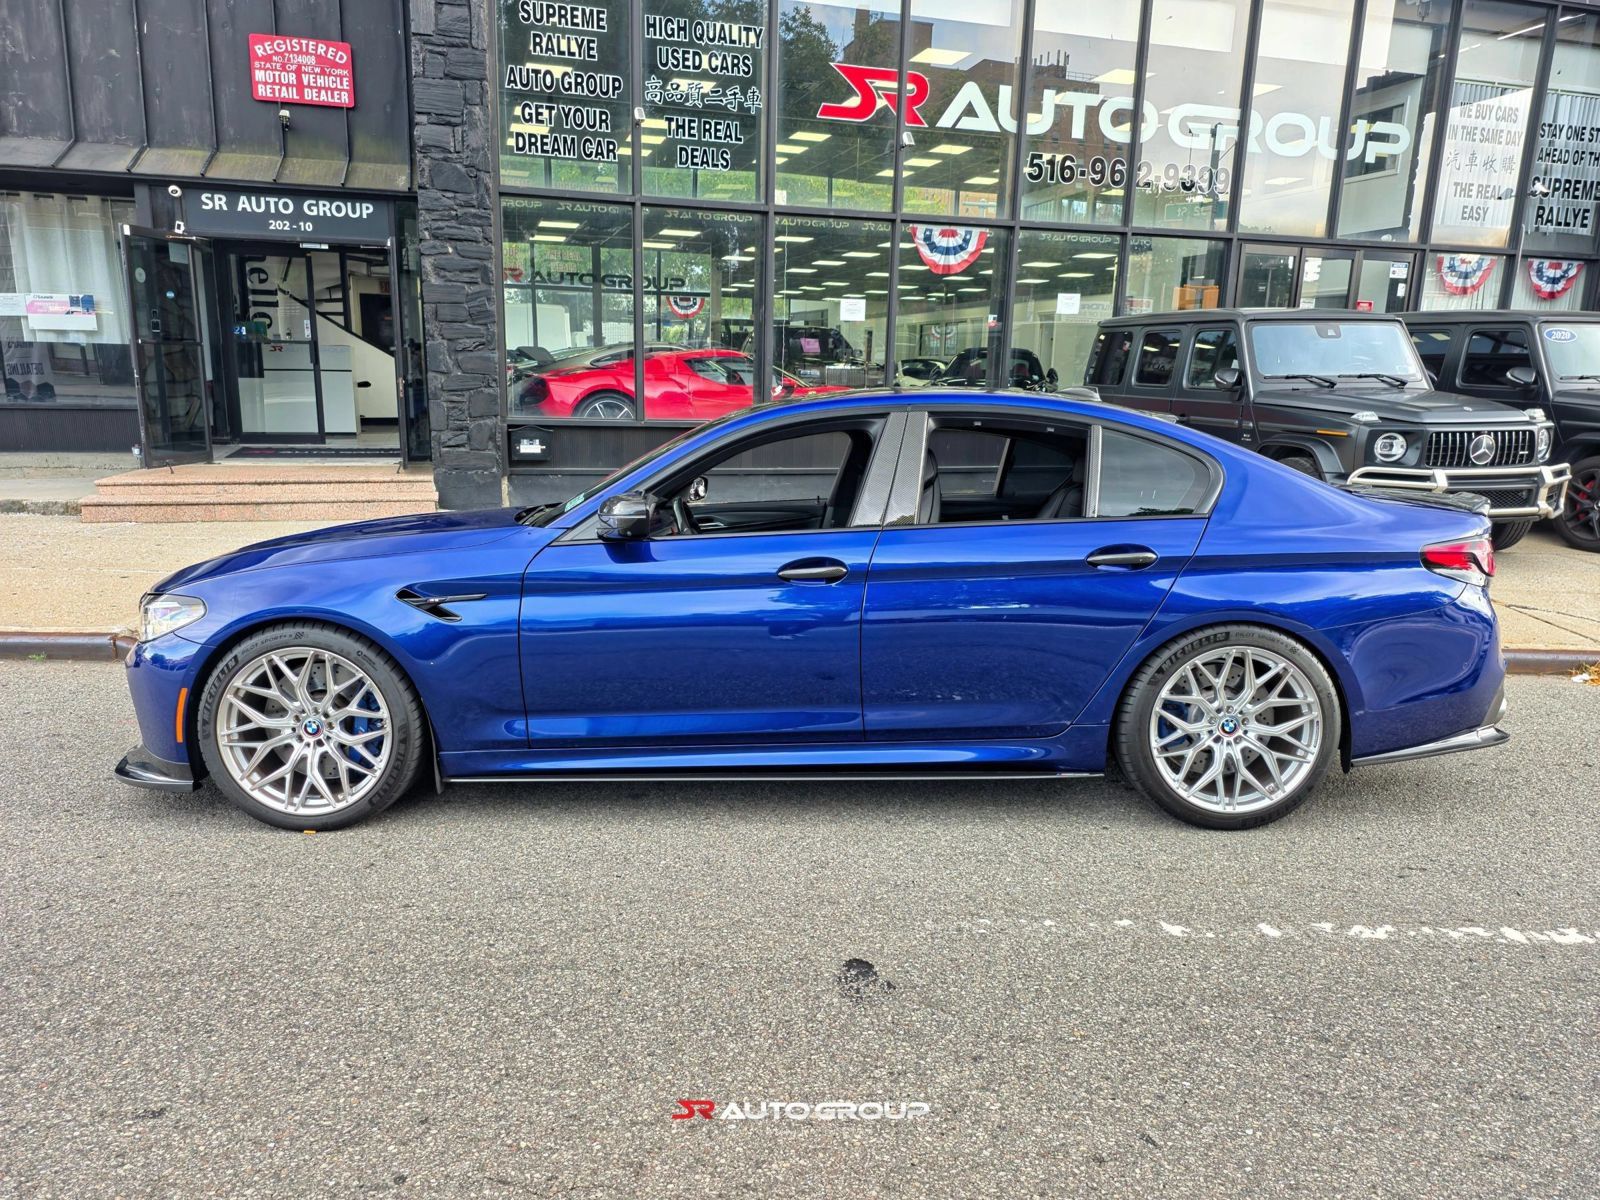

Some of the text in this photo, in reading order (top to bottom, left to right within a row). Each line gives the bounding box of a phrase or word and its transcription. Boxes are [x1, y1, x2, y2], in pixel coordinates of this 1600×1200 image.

[519, 0, 607, 32] SUPREME
[645, 14, 765, 49] HIGH QUALITY
[254, 38, 347, 64] REGISTERED
[531, 31, 598, 61] RALLYE
[254, 61, 349, 77] STATE OF NEW YORK
[657, 46, 752, 78] USED CARS
[255, 70, 350, 89] MOTOR VEHICLE
[505, 65, 623, 98] AUTO GROUP
[257, 84, 349, 104] RETAIL DEALER
[645, 74, 762, 114] 高品質二手車
[520, 101, 611, 132] GET YOUR
[817, 62, 1411, 164] SR AUTO GROUP
[1459, 102, 1519, 123] WE BUY CARS
[663, 115, 743, 144] THE REAL
[1448, 124, 1524, 147] IN THE SAME DAY
[1539, 122, 1565, 140] STAY
[1565, 124, 1587, 142] ONE
[514, 131, 618, 162] DREAM CAR
[1536, 147, 1571, 165] AHEAD
[1572, 150, 1586, 166] OF
[677, 146, 731, 171] DEALS
[1453, 181, 1475, 198] THE
[201, 194, 374, 218] SR AUTO GROUP
[573, 205, 607, 213] AUTO
[713, 213, 752, 222] GROUP
[1461, 205, 1489, 222] EASY
[1534, 205, 1590, 229] RALLYE
[781, 218, 811, 228] AUTO
[530, 270, 598, 287] AUTO
[600, 274, 686, 291] GROUP
[1552, 331, 1571, 340] 2020
